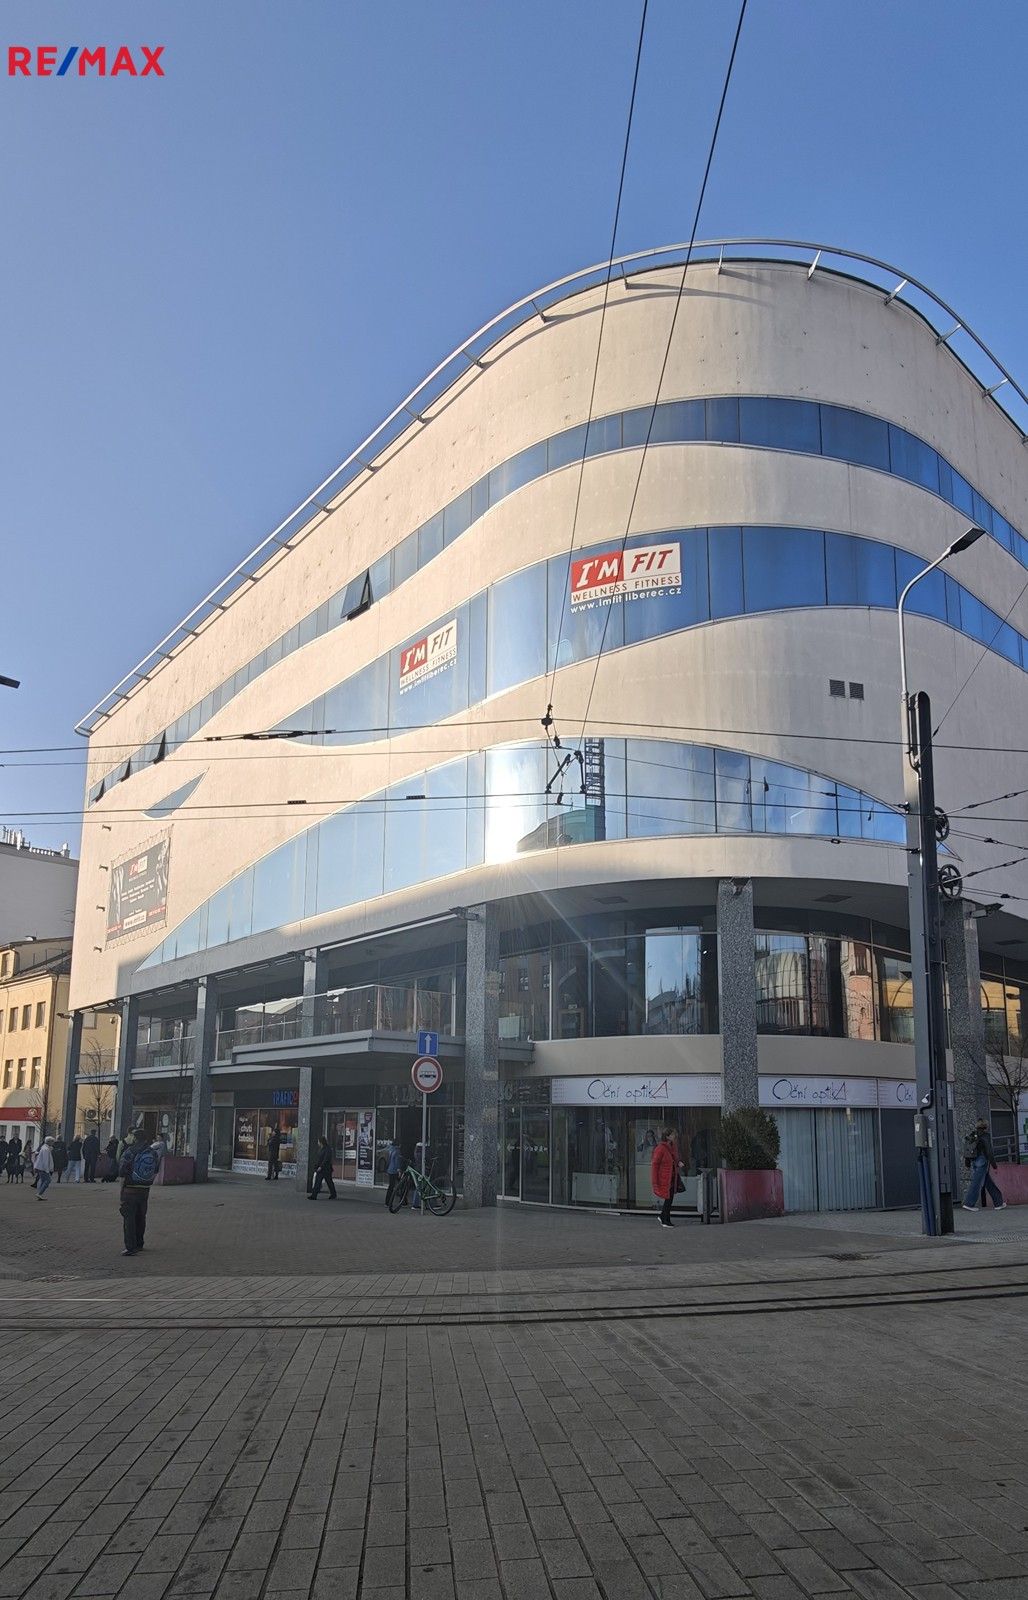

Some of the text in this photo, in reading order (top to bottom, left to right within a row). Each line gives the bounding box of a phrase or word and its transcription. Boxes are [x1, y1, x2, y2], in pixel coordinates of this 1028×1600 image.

[576, 549, 673, 588] I'M FIT
[572, 575, 681, 602] WELLNESS FITNESS
[401, 647, 456, 685] WELLNESS FITNESS
[402, 626, 453, 674] I'M FIT
[587, 1079, 620, 1100] Oční
[772, 1079, 807, 1100] Oční
